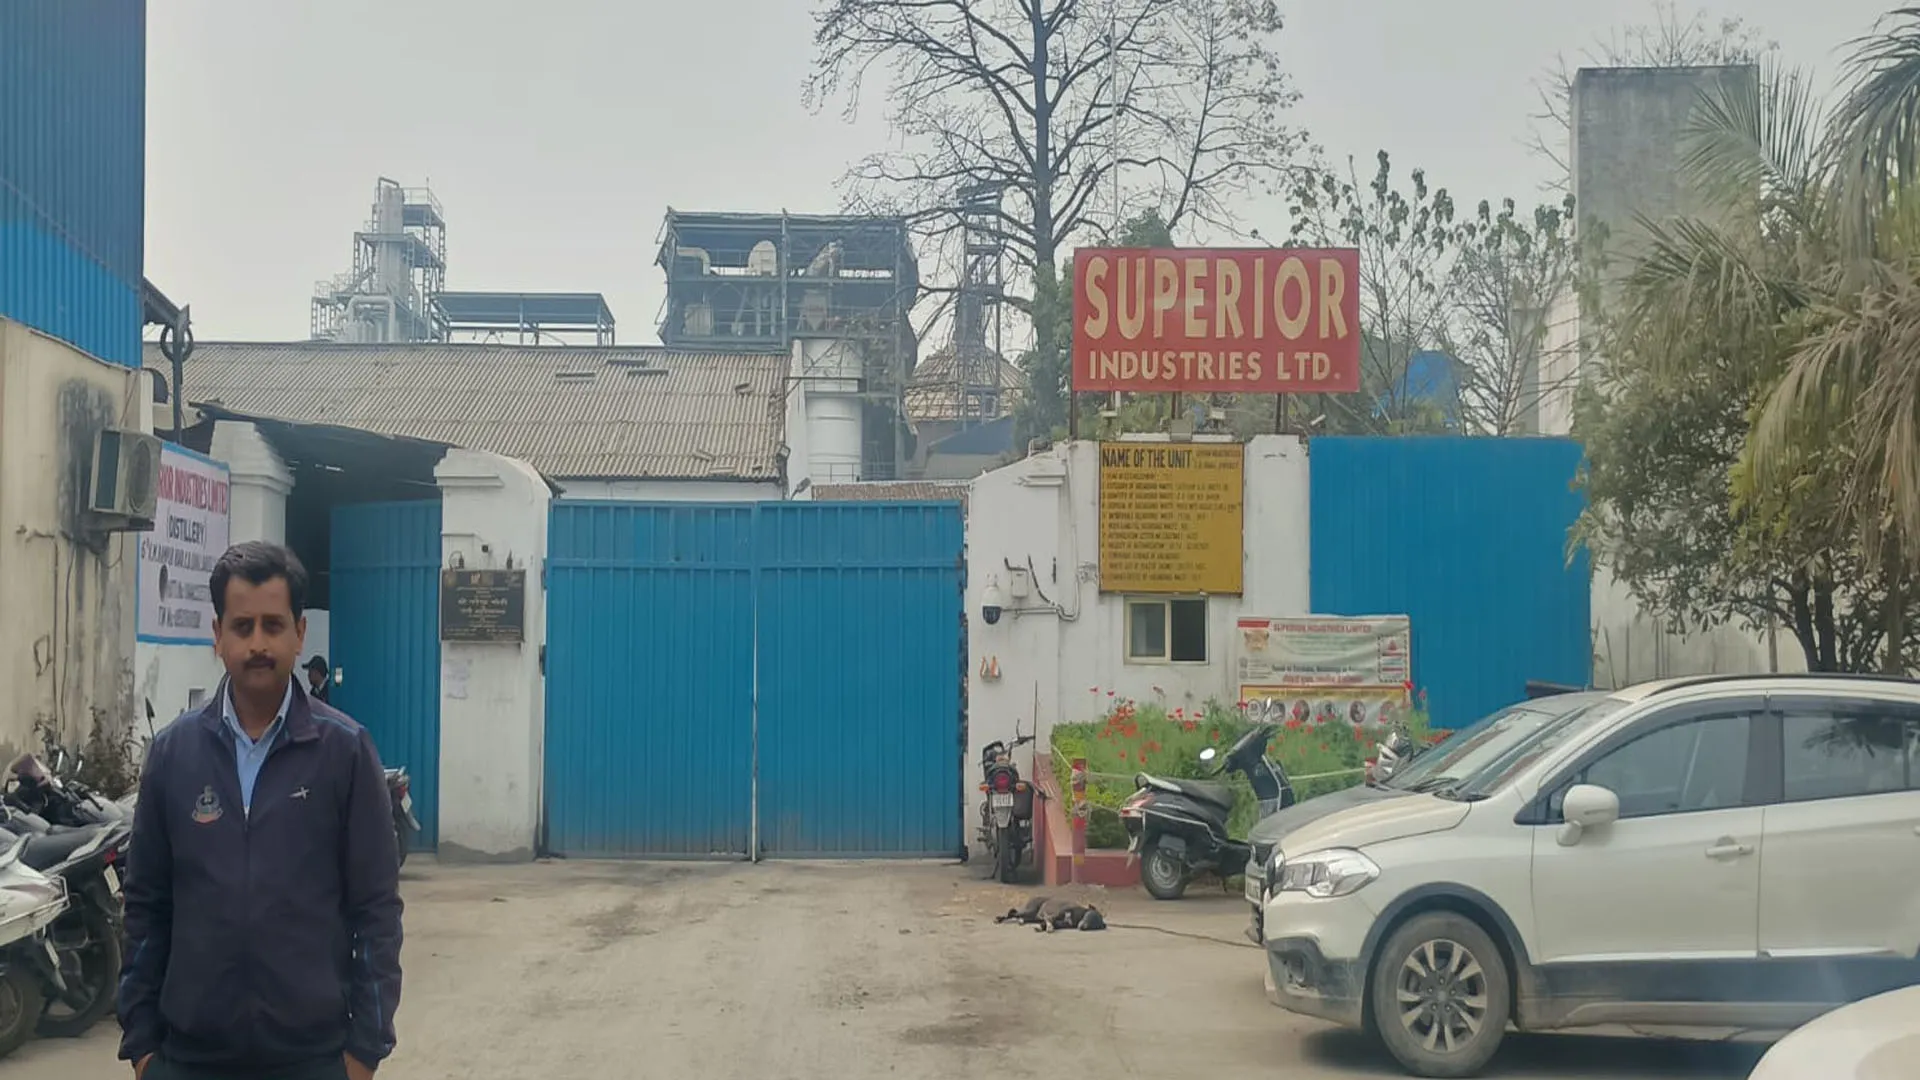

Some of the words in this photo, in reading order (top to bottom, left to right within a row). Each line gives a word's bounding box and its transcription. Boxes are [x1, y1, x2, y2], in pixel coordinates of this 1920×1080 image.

[1084, 256, 1349, 340] SUPERIOR
[1089, 351, 1262, 381] INDUSTRIES
[1277, 352, 1342, 381] LTD.
[1102, 448, 1130, 468] NAME
[1134, 448, 1144, 468] OF
[1147, 448, 1165, 468] THE
[1168, 449, 1192, 468] UNIT
